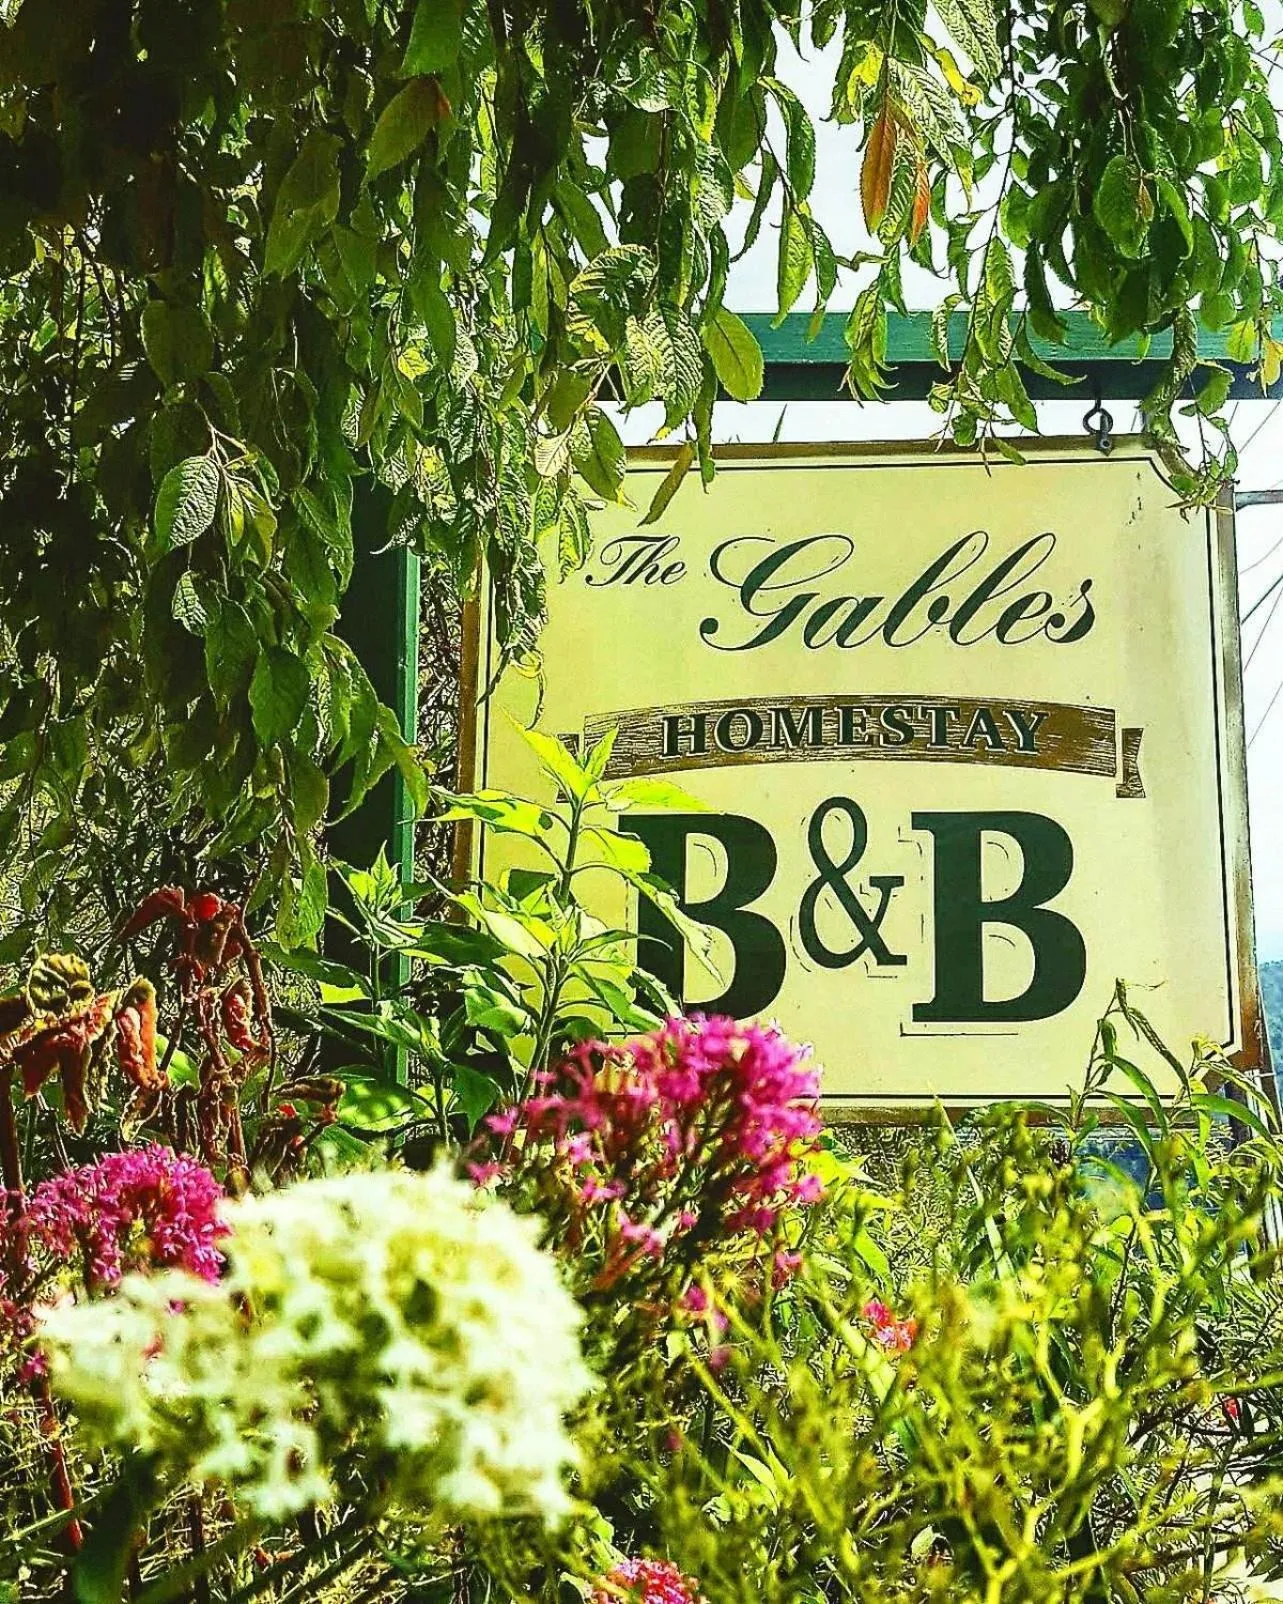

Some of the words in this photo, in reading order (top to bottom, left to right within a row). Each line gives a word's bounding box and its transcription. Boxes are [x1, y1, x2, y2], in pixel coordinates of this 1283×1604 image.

[585, 533, 687, 587] The
[699, 530, 1096, 651] Gables
[660, 704, 1049, 759] HOMESTAY
[612, 796, 1087, 1023] B&B
